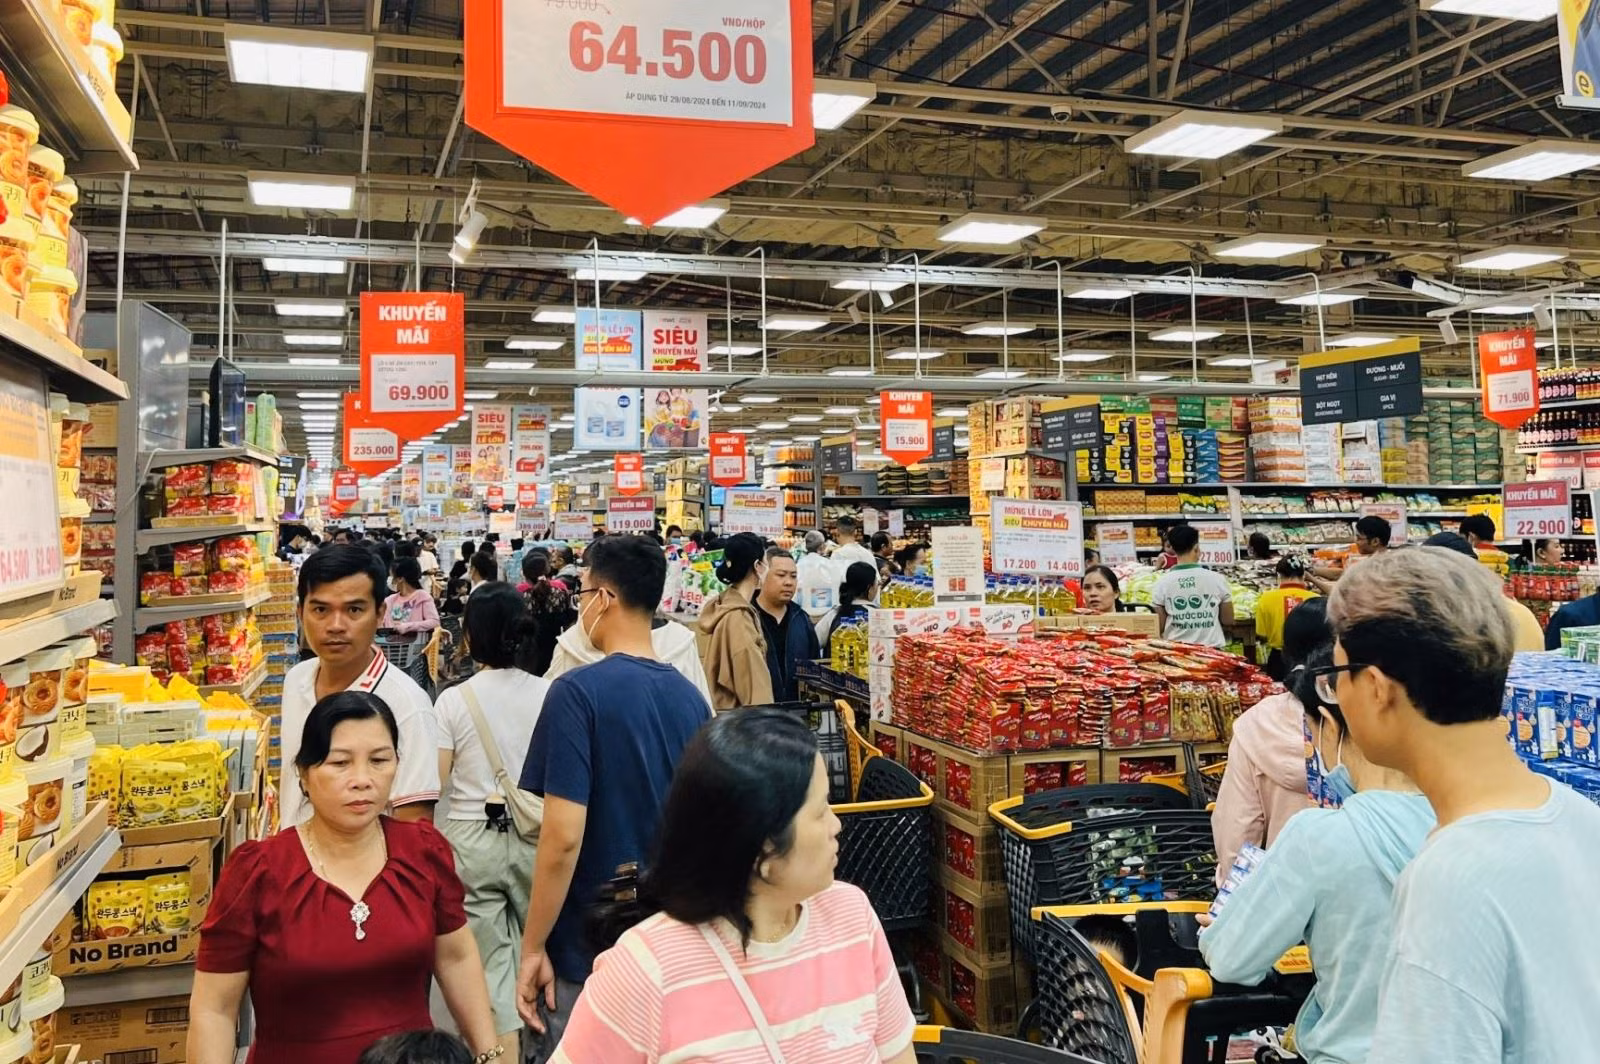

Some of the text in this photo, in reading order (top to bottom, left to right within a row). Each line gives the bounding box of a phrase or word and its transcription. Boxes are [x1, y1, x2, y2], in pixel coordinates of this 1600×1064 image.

[568, 21, 767, 84] 64.500
[625, 91, 635, 100] ÁP
[727, 99, 766, 109] 11/09/2024
[378, 300, 447, 321] KHUYẾN
[396, 326, 429, 344] MÃI
[653, 325, 698, 345] SIÊU
[1488, 335, 1526, 352] KHUYẾN
[683, 347, 698, 355] MÃI
[1498, 353, 1517, 367] MÃI
[388, 385, 449, 401] 69.900
[1498, 391, 1530, 405] 71.900
[478, 411, 505, 423] SIÊU
[896, 436, 924, 445] 15.900
[353, 445, 394, 456] 235.000
[1506, 486, 1557, 501] KHUYẾN MÃI
[611, 499, 648, 509] KHUYẾN MÃI
[1004, 504, 1053, 517] MỪNG LỄ LỚN
[612, 519, 652, 529] 119.000
[1003, 517, 1068, 530] SIÊU KHUYẾN MÃI
[1516, 519, 1566, 536] 22.900
[1200, 551, 1232, 563] 27.800
[1003, 559, 1079, 572] 17.200 14.400
[1173, 610, 1213, 620] NƯỚC DỪA
[923, 623, 938, 633] HEO
[131, 784, 172, 797] 완두콩 스낵
[181, 777, 206, 791] 콩 스낵
[96, 906, 137, 919] 완두콩 스낵
[155, 900, 179, 913] 완두콩
[70, 947, 102, 964] No
[107, 935, 178, 960] Brand
